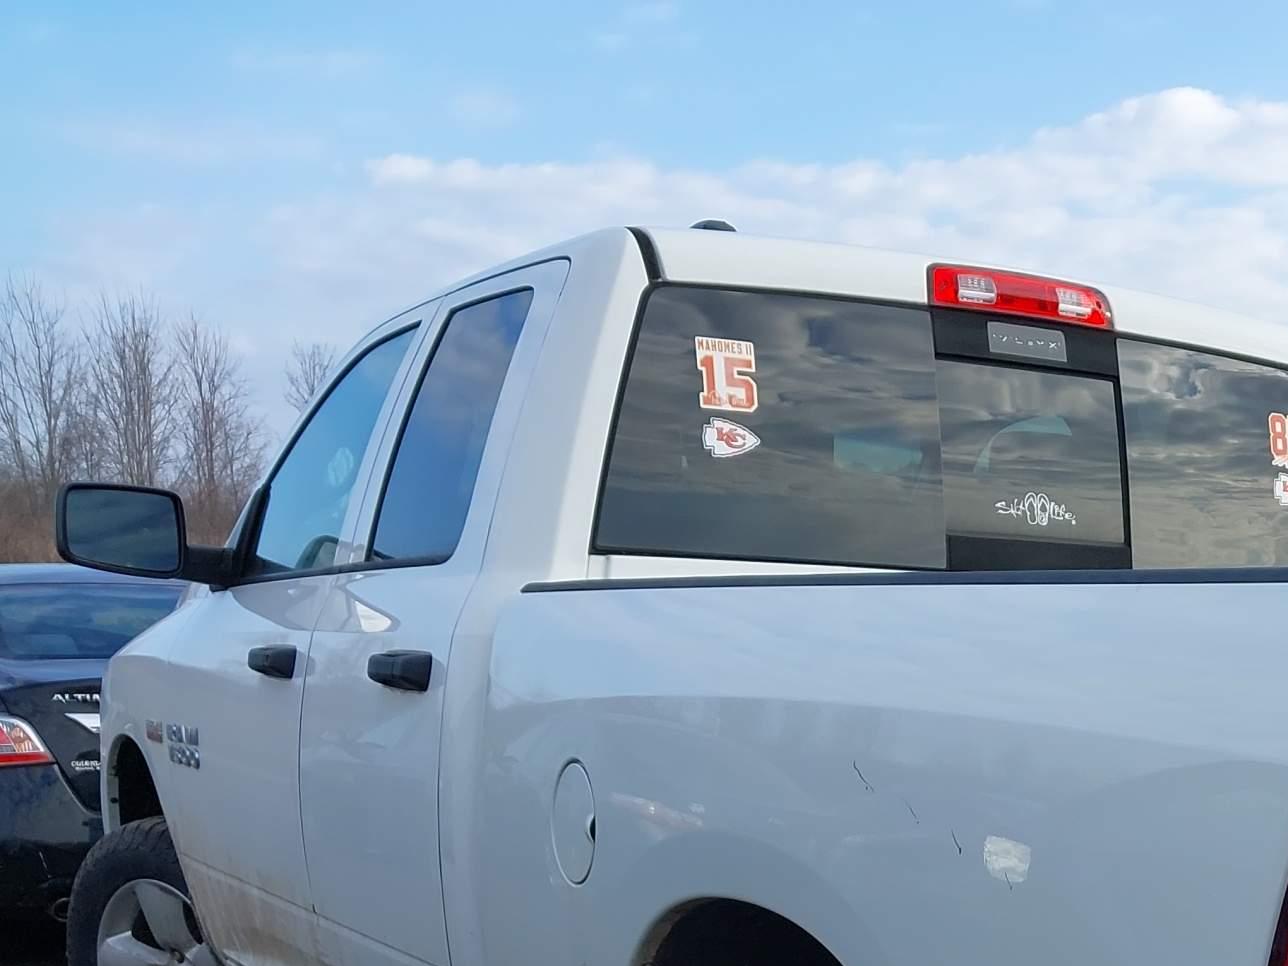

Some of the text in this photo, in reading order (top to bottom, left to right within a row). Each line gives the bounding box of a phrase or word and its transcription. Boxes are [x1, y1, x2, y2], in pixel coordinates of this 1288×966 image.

[697, 338, 743, 354] MAHOMES
[699, 354, 757, 409] 15
[715, 426, 747, 449] KC
